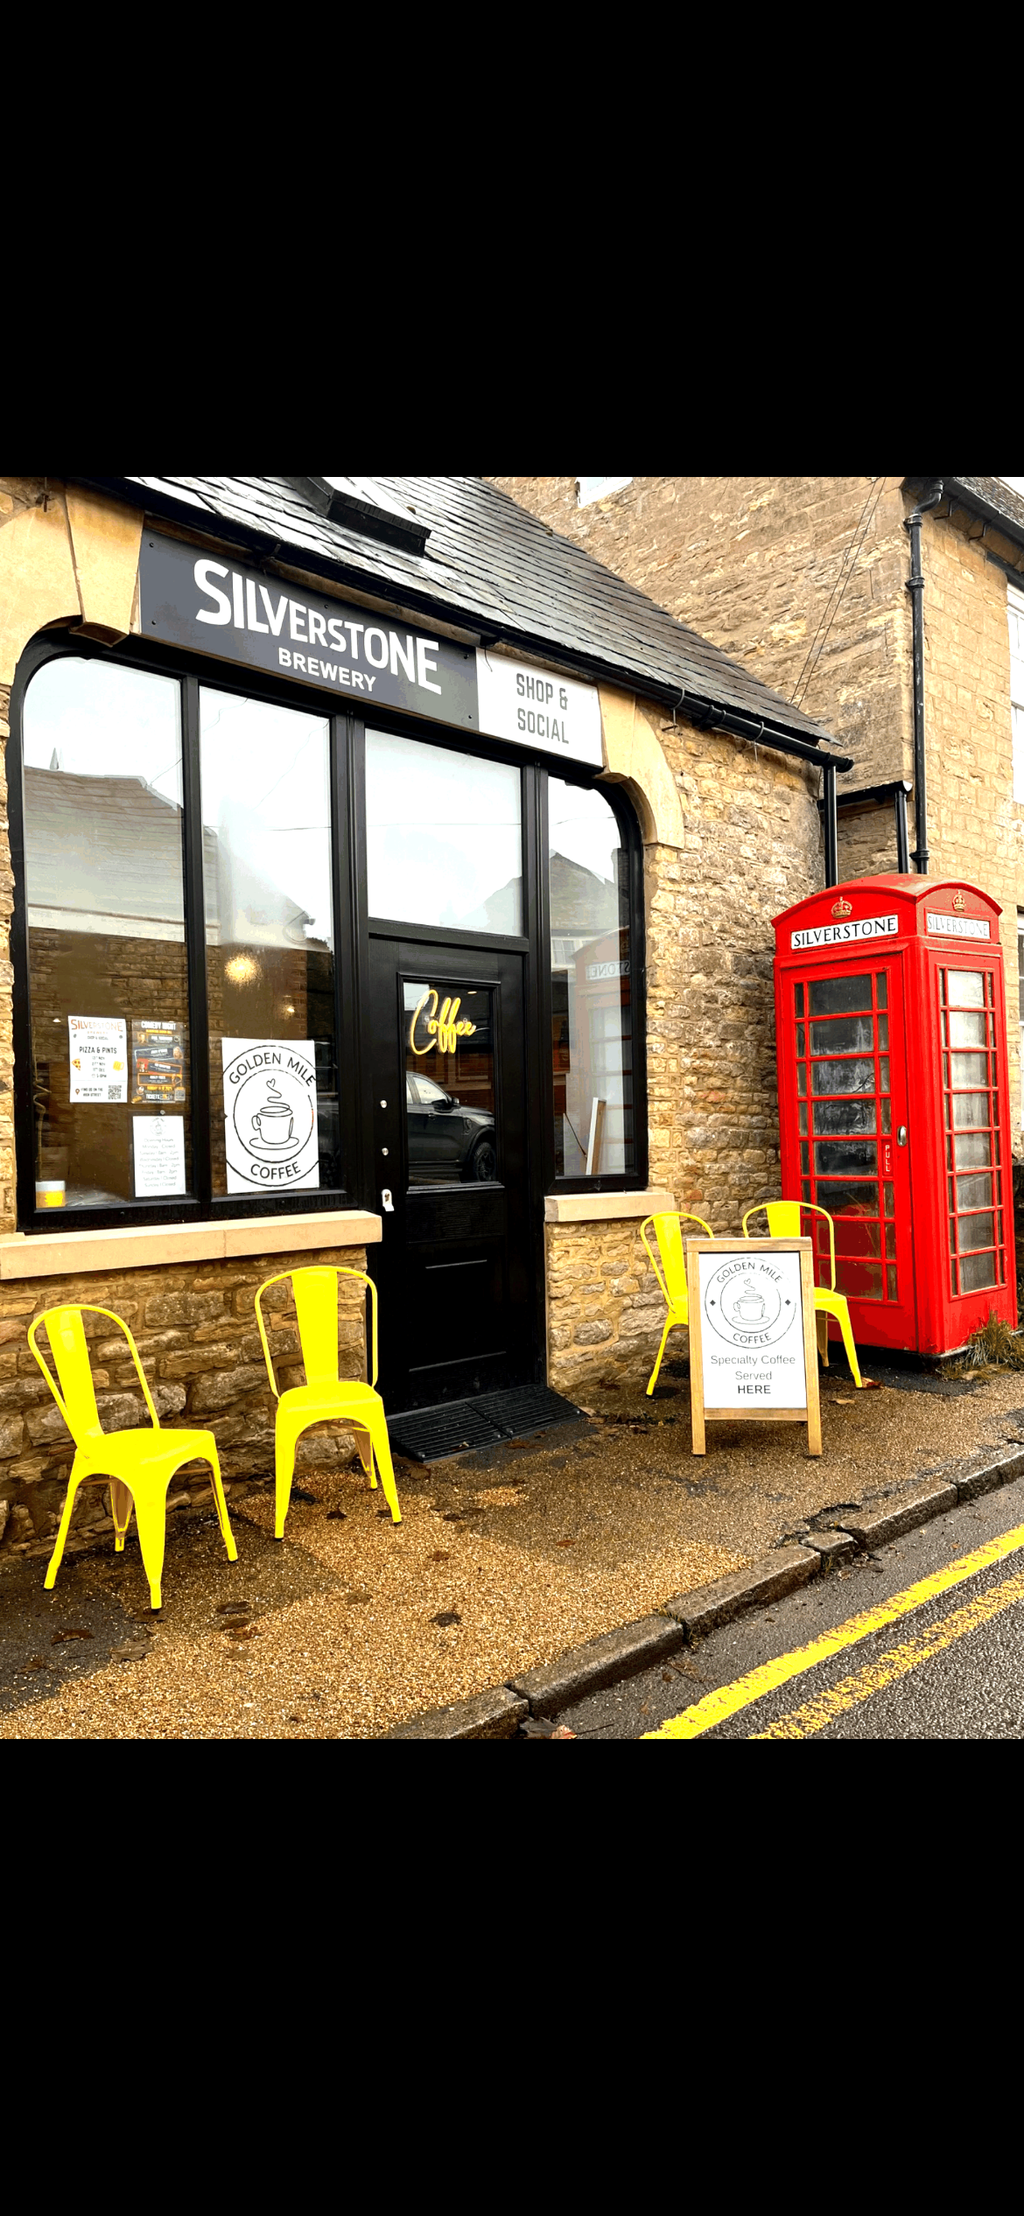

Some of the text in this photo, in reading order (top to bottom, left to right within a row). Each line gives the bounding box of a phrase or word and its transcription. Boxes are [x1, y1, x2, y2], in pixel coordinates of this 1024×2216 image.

[193, 558, 442, 695] SILVERSTONE
[278, 647, 376, 692] BREWERY
[516, 673, 568, 711] SHOP &
[517, 707, 569, 744] SOCIAL
[793, 917, 896, 947] SILVERSTONE
[927, 915, 988, 937] SILVERSTONE
[71, 1019, 123, 1032] SILVERSTONE
[410, 989, 477, 1055] Coffee
[79, 1046, 95, 1054] PIZZA
[102, 1047, 117, 1055] PINTS
[229, 1052, 316, 1087] GOLDEN MILE
[250, 1161, 302, 1180] COFFEE
[716, 1262, 783, 1283] GOLDEN MILE
[732, 1332, 772, 1344] COFFEE
[710, 1355, 796, 1366] Specialty Coffee
[735, 1371, 772, 1381] Served
[737, 1385, 771, 1394] HERE
